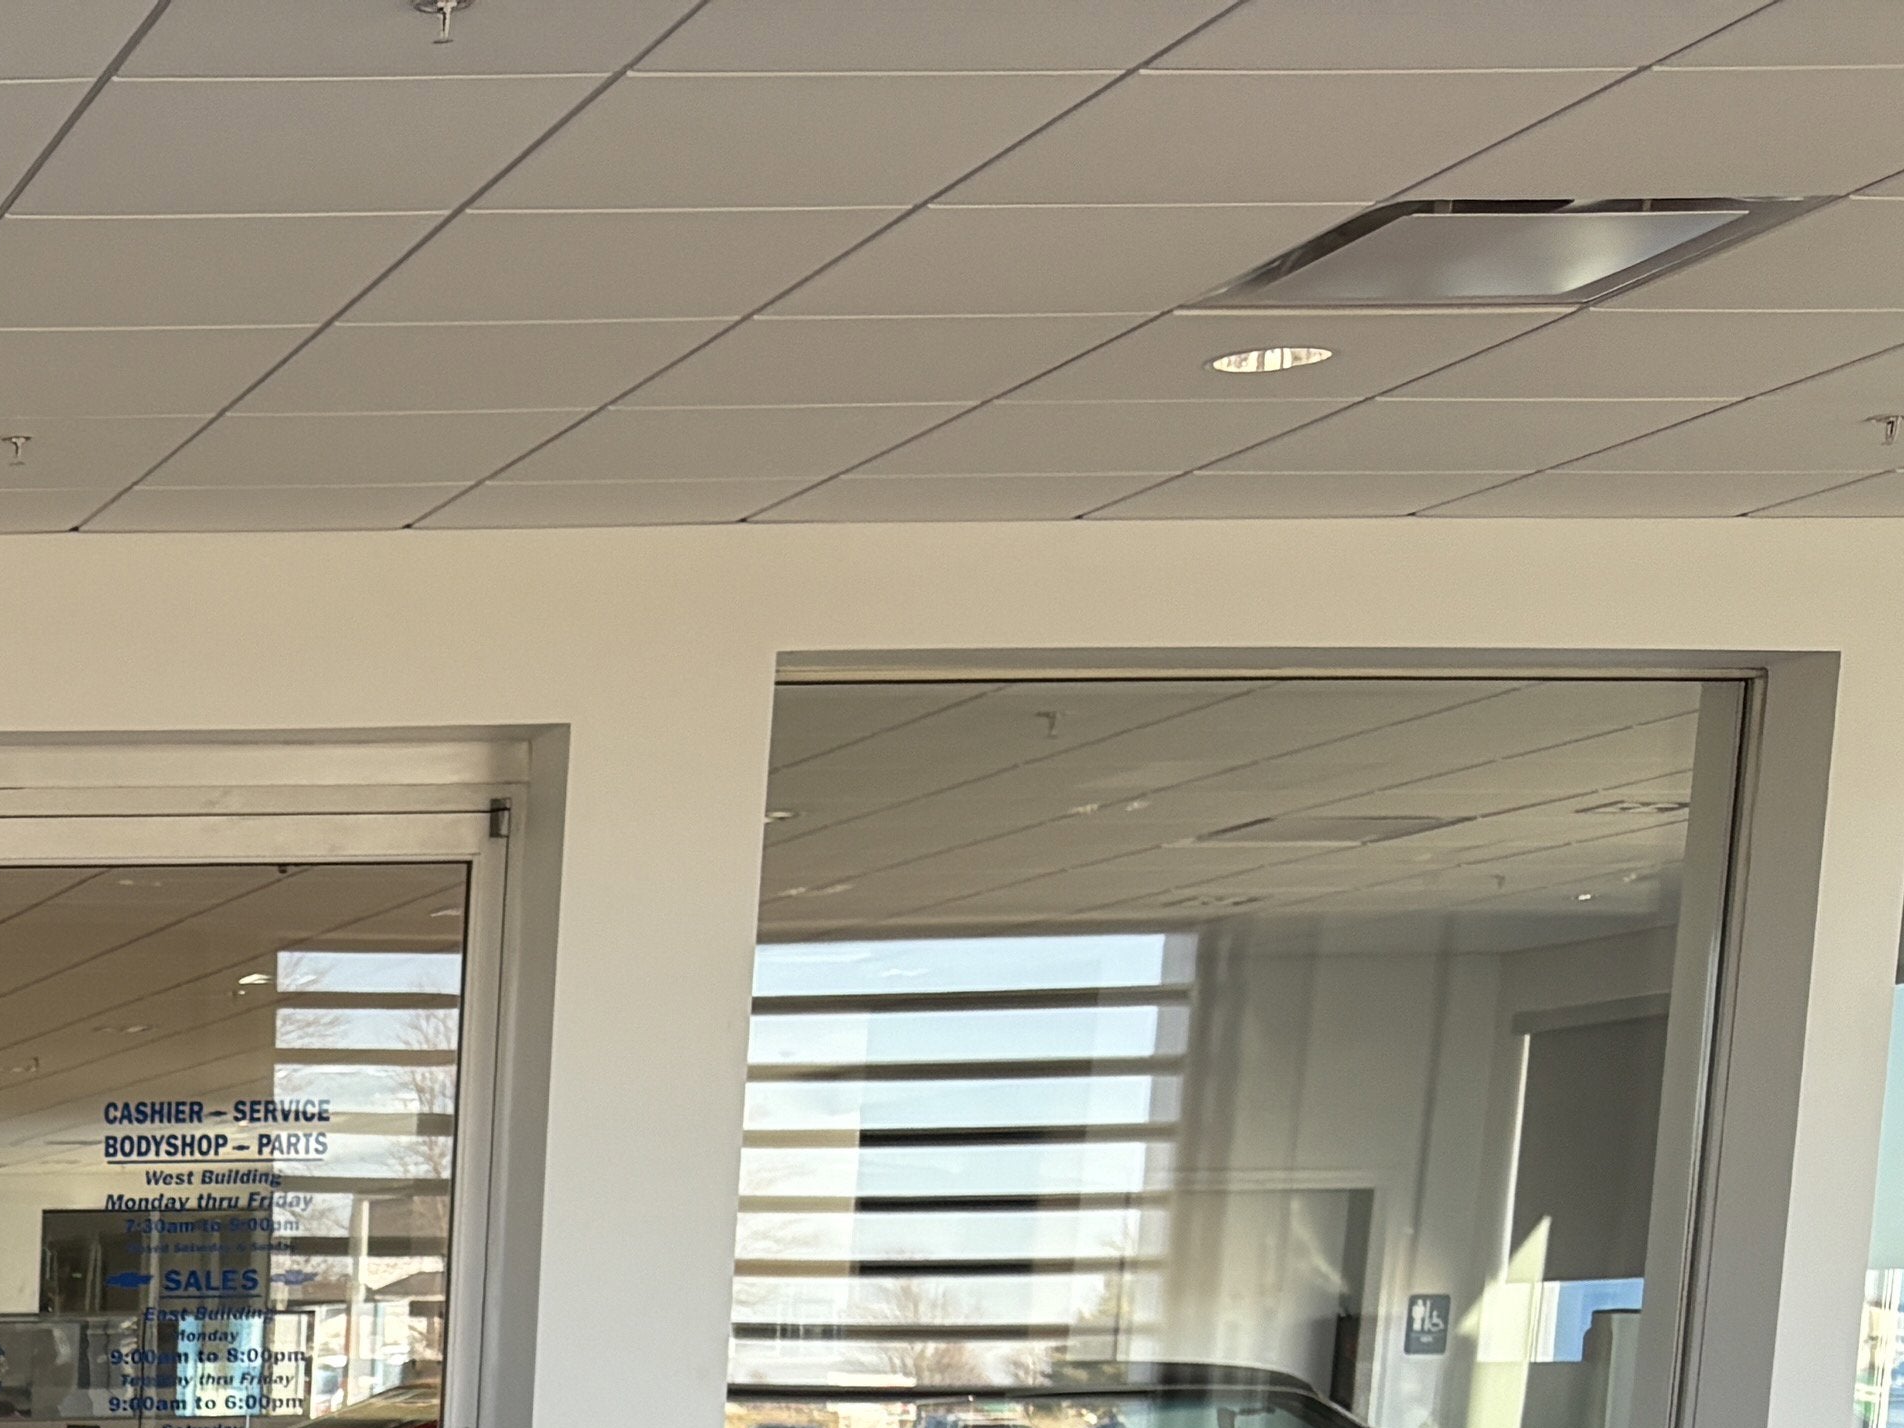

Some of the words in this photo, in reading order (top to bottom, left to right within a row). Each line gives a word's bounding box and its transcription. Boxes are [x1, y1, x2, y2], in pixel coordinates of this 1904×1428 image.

[104, 1101, 204, 1124] CASHIER
[233, 1099, 331, 1122] SERVICE
[104, 1133, 228, 1158] BODYSHOP
[258, 1132, 328, 1156] PARTS
[145, 1170, 194, 1186] West
[201, 1169, 282, 1187] Building
[104, 1194, 190, 1212] Monday
[197, 1193, 240, 1210] thru
[247, 1191, 314, 1211] Friday
[202, 1217, 222, 1234] to
[163, 1268, 259, 1292] SALES
[145, 1306, 187, 1321] East
[194, 1305, 275, 1323] Building
[110, 1349, 189, 1365] 9:00am
[198, 1349, 219, 1364] to
[226, 1347, 306, 1366] 8:00pm
[199, 1372, 234, 1386] thru
[240, 1372, 294, 1389] Friday
[108, 1395, 187, 1412] 9:00am
[195, 1395, 217, 1411] to
[224, 1394, 304, 1412] 6:00pm
